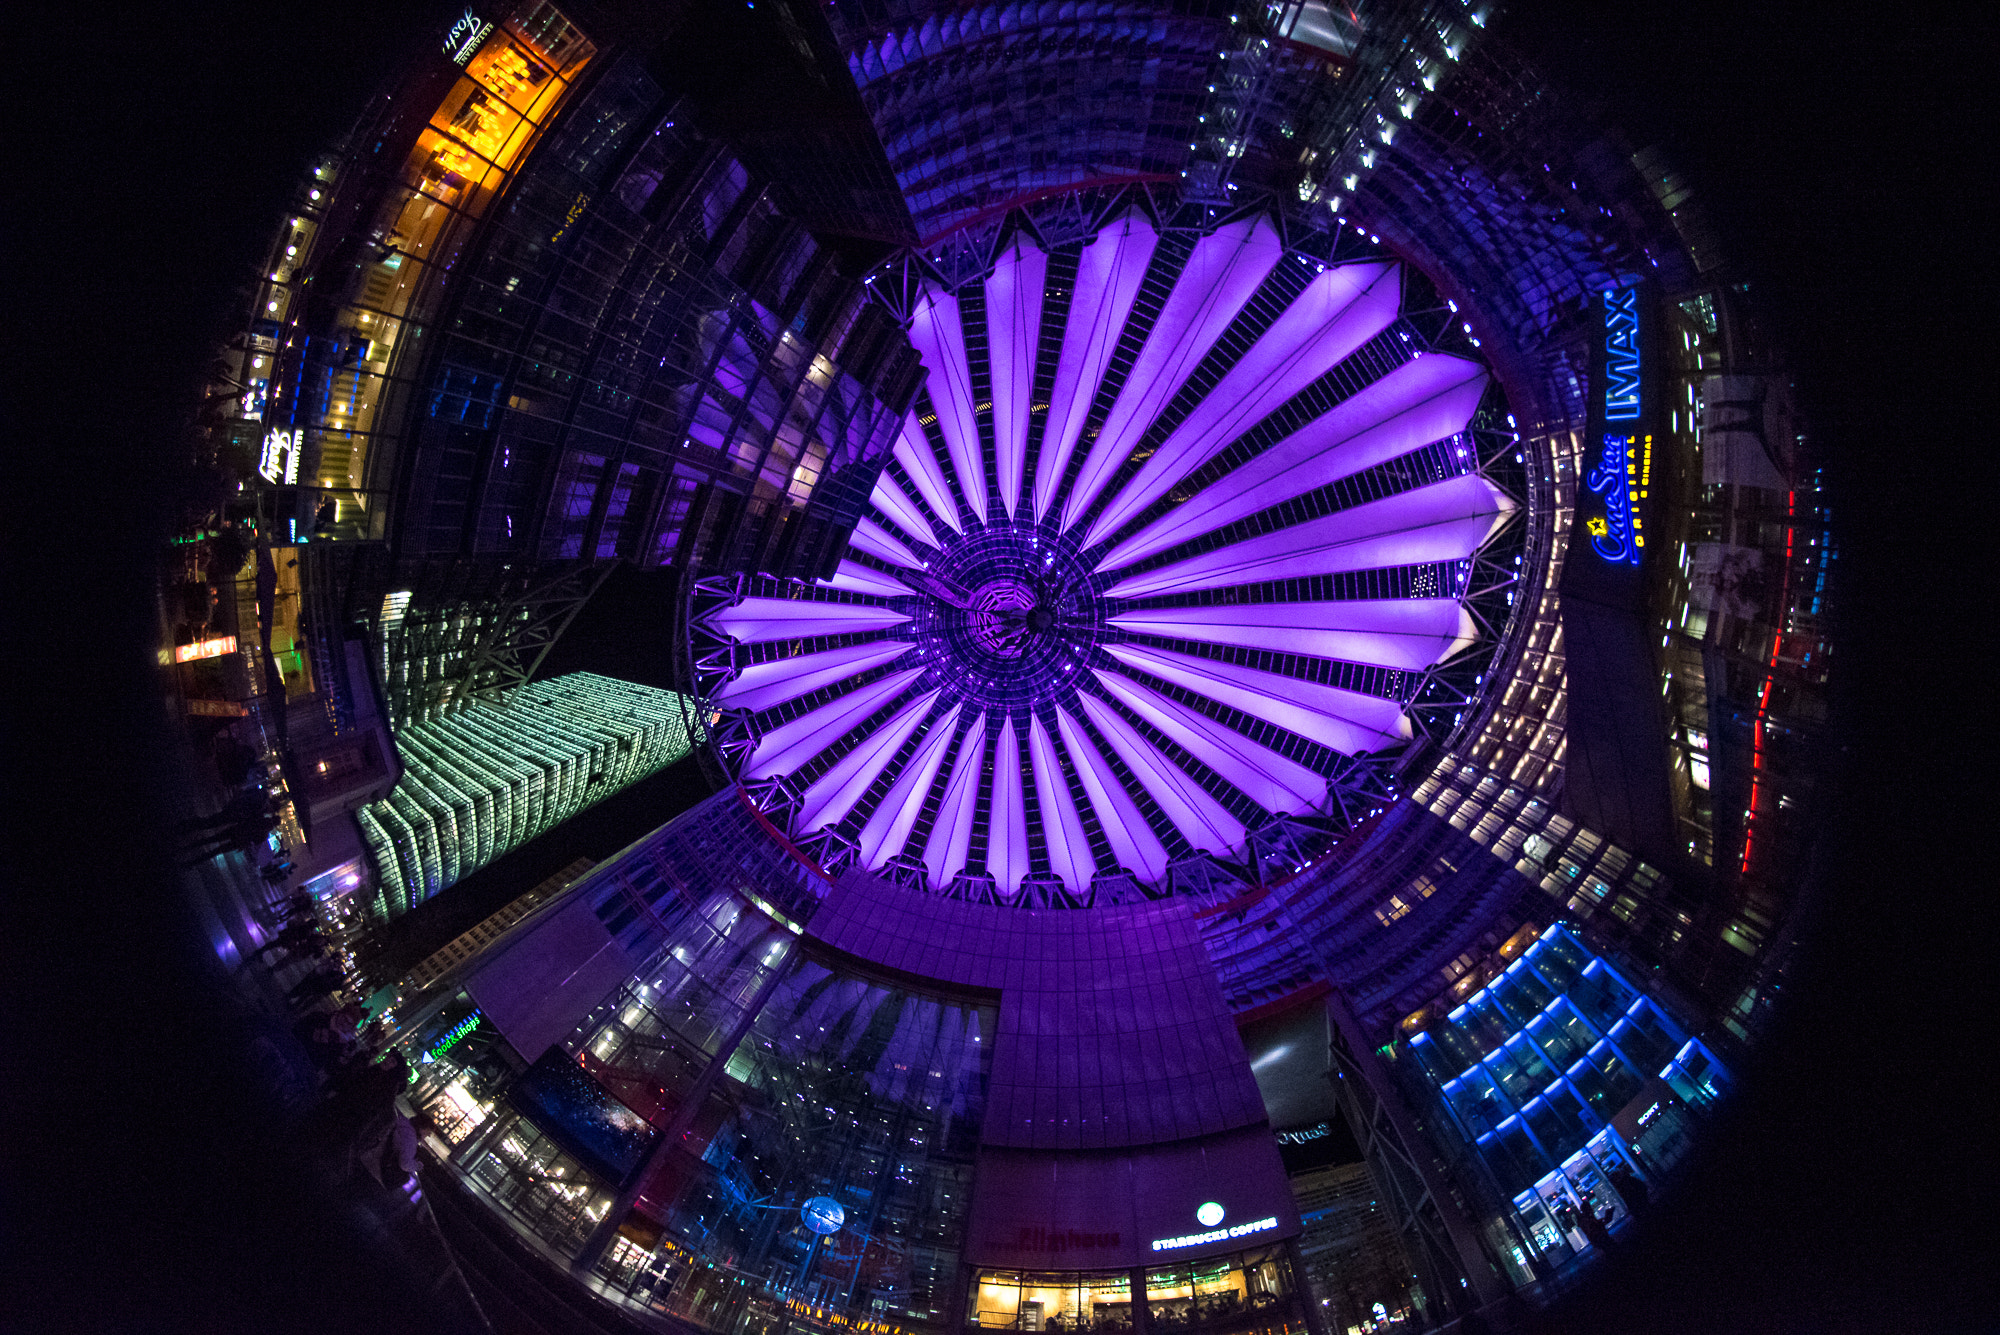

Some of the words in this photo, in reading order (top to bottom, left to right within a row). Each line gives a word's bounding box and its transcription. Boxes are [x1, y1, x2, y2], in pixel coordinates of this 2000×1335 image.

[459, 23, 494, 67] RESTAURANT
[1604, 289, 1640, 420] IMAX
[258, 427, 291, 485] Josty
[1641, 435, 1652, 486] CINEMAS
[1588, 433, 1628, 562] CineStar
[1627, 435, 1645, 547] ORIGINAL
[1637, 1101, 1660, 1126] SONY
[1152, 1228, 1229, 1251] STARBUCKS
[1228, 1216, 1278, 1238] COFFEE
